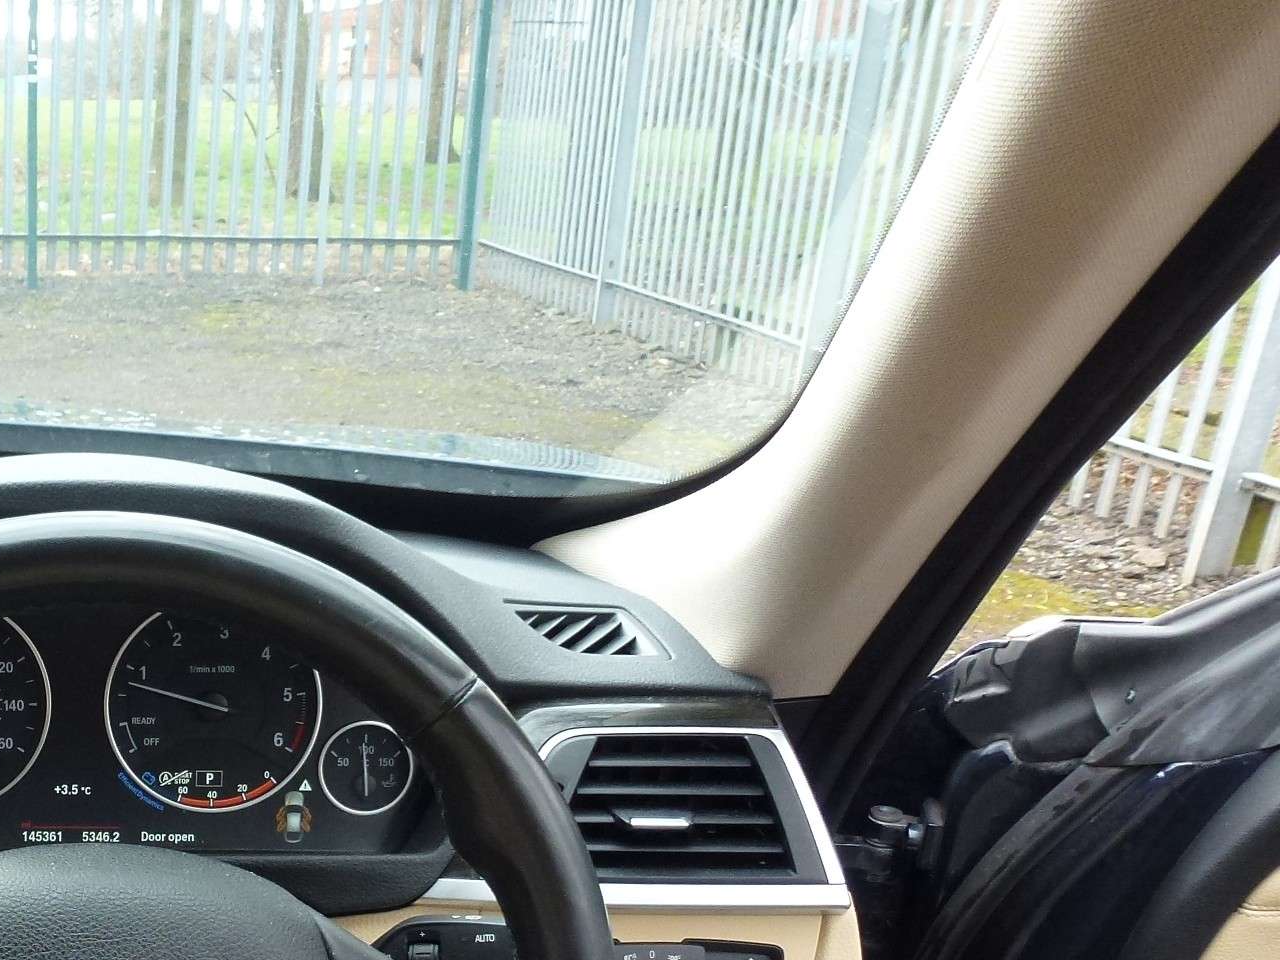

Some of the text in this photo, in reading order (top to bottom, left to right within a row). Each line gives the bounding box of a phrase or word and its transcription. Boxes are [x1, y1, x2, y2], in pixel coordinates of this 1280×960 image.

[172, 632, 183, 647] 2
[261, 645, 272, 661] 4
[138, 665, 147, 681] 1
[282, 687, 293, 702] 5
[3, 699, 25, 712] 140
[131, 717, 156, 725] READY
[143, 737, 160, 746] OFF
[273, 732, 284, 747] 6
[336, 757, 350, 767] 50
[378, 757, 395, 767] 150
[205, 772, 215, 785] P
[54, 784, 79, 796] +3.5
[177, 786, 189, 795] 60
[237, 784, 248, 792] 20
[206, 790, 218, 799] 40
[22, 831, 63, 843] 145361
[82, 831, 120, 843] 5346.2
[141, 831, 196, 845] Door open
[475, 933, 495, 943] AUTO
